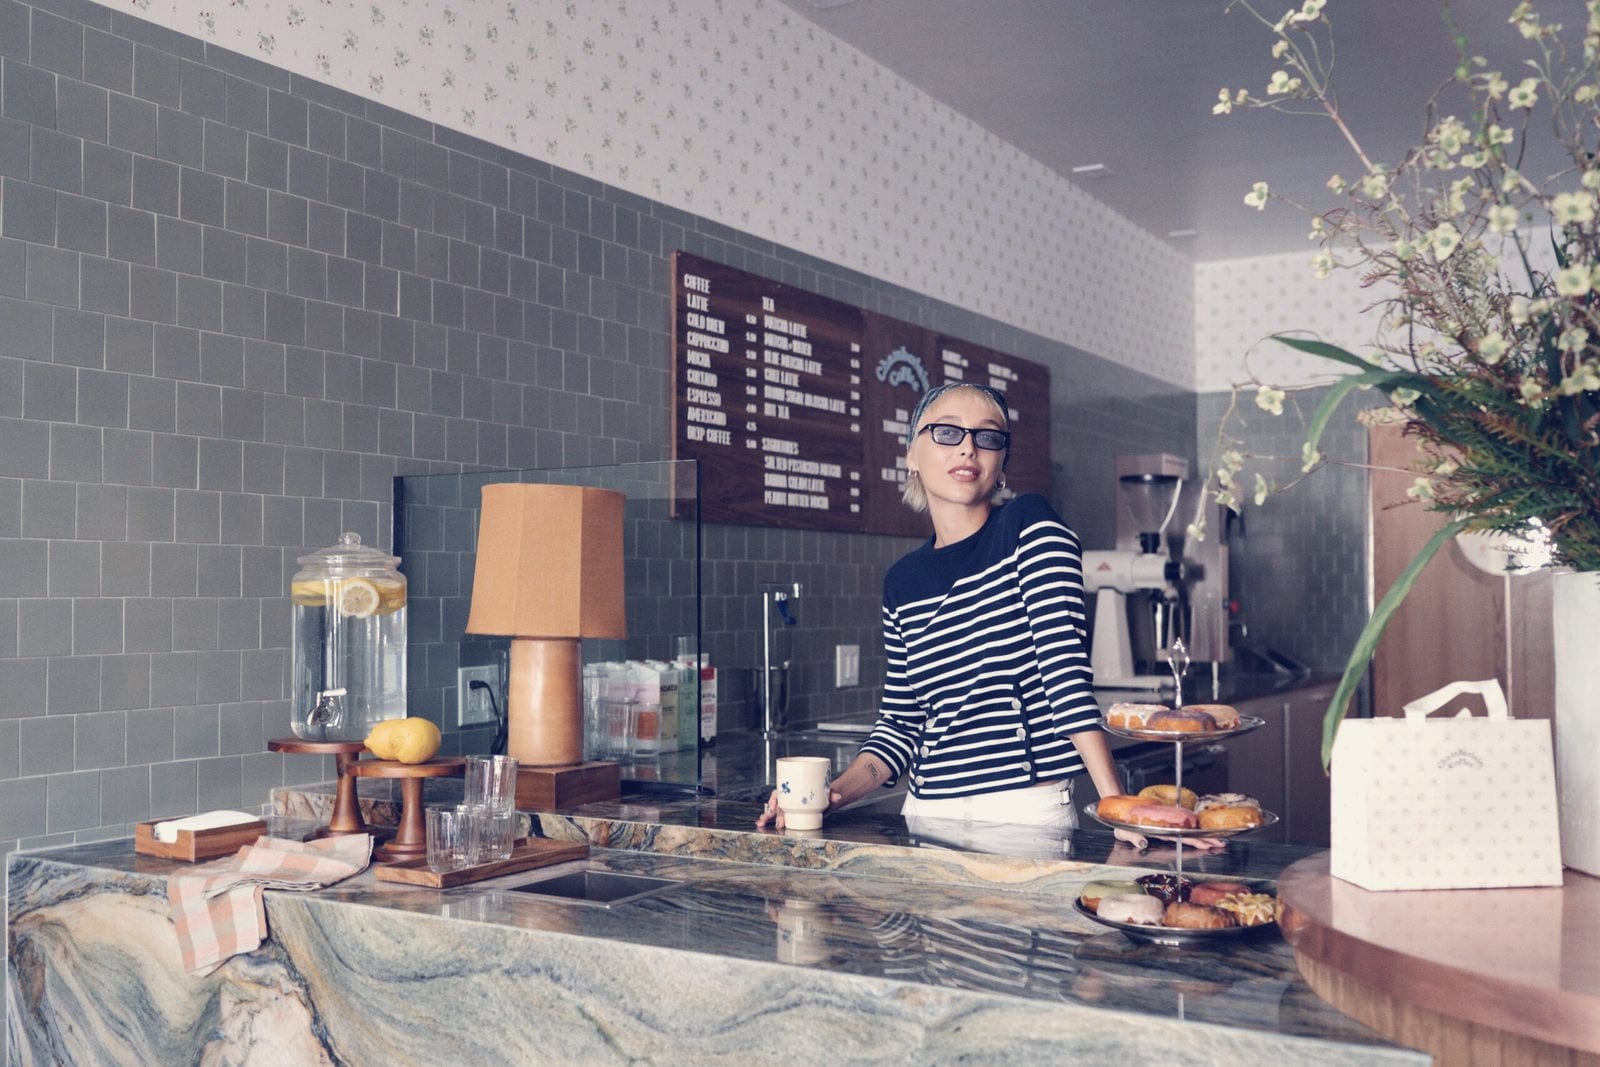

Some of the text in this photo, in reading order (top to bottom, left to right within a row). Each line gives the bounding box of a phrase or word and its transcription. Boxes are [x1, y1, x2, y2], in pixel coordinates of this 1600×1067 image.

[684, 274, 710, 294] COFFEE
[687, 294, 709, 312] LATTE
[762, 296, 775, 312] TEA
[687, 313, 725, 335] COLD BREW
[789, 321, 807, 338] LATTE
[687, 331, 729, 354] CAPPUCCINO
[687, 349, 711, 368] MOCHA
[805, 360, 822, 376] LATTE
[687, 369, 718, 388] CORTADO
[780, 371, 799, 388] LATTE
[687, 387, 721, 407] ESPRESSO
[829, 397, 846, 414] LATTE
[687, 406, 727, 426] AMERICANO
[777, 404, 790, 420] TEA
[687, 425, 732, 446] DRIP COFFEE
[788, 458, 820, 476] PISTACHIO
[807, 478, 826, 493] LATTE
[810, 495, 829, 510] MOCHA
